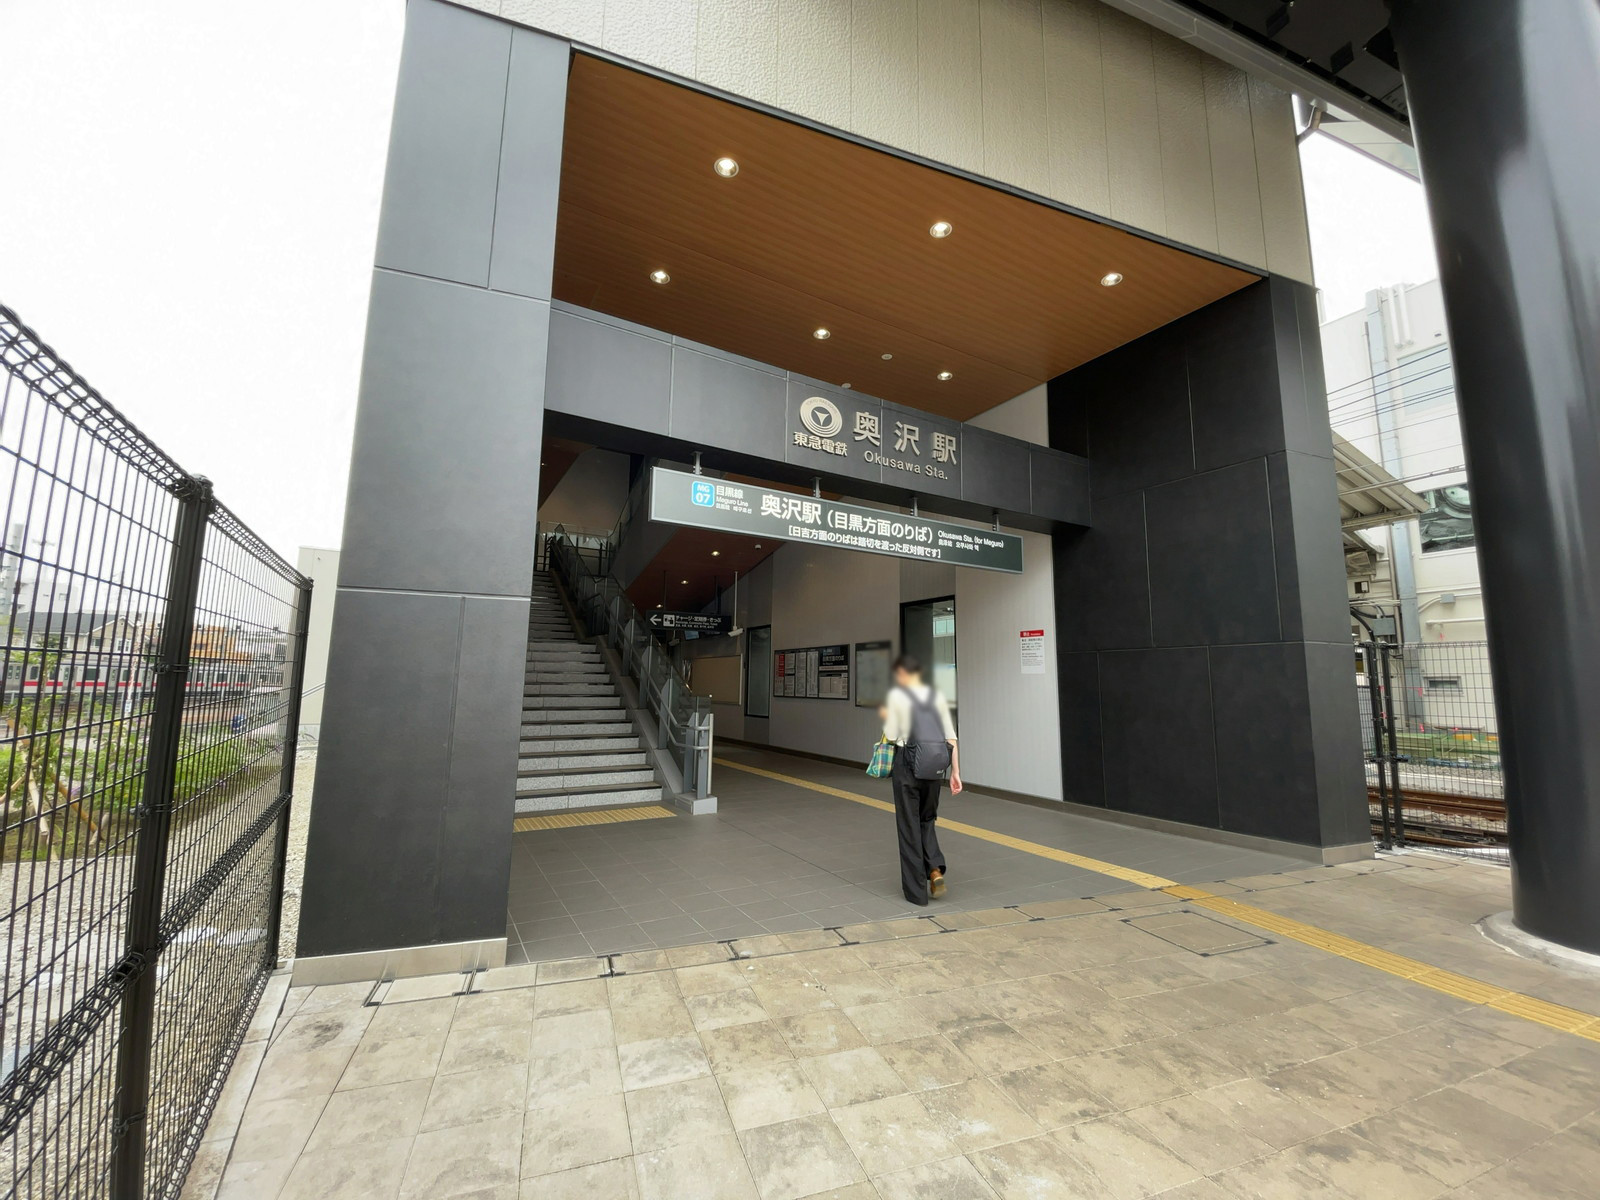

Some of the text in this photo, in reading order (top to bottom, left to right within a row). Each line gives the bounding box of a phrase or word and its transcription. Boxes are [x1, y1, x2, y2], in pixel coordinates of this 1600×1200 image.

[792, 431, 848, 457] 東急電鉄
[853, 411, 957, 465] 奥沢駅
[864, 450, 948, 480] Okusawa Sta.
[696, 484, 710, 493] MG
[716, 485, 744, 499] 目黒線
[695, 492, 711, 504] 07
[716, 496, 737, 505] Meguro
